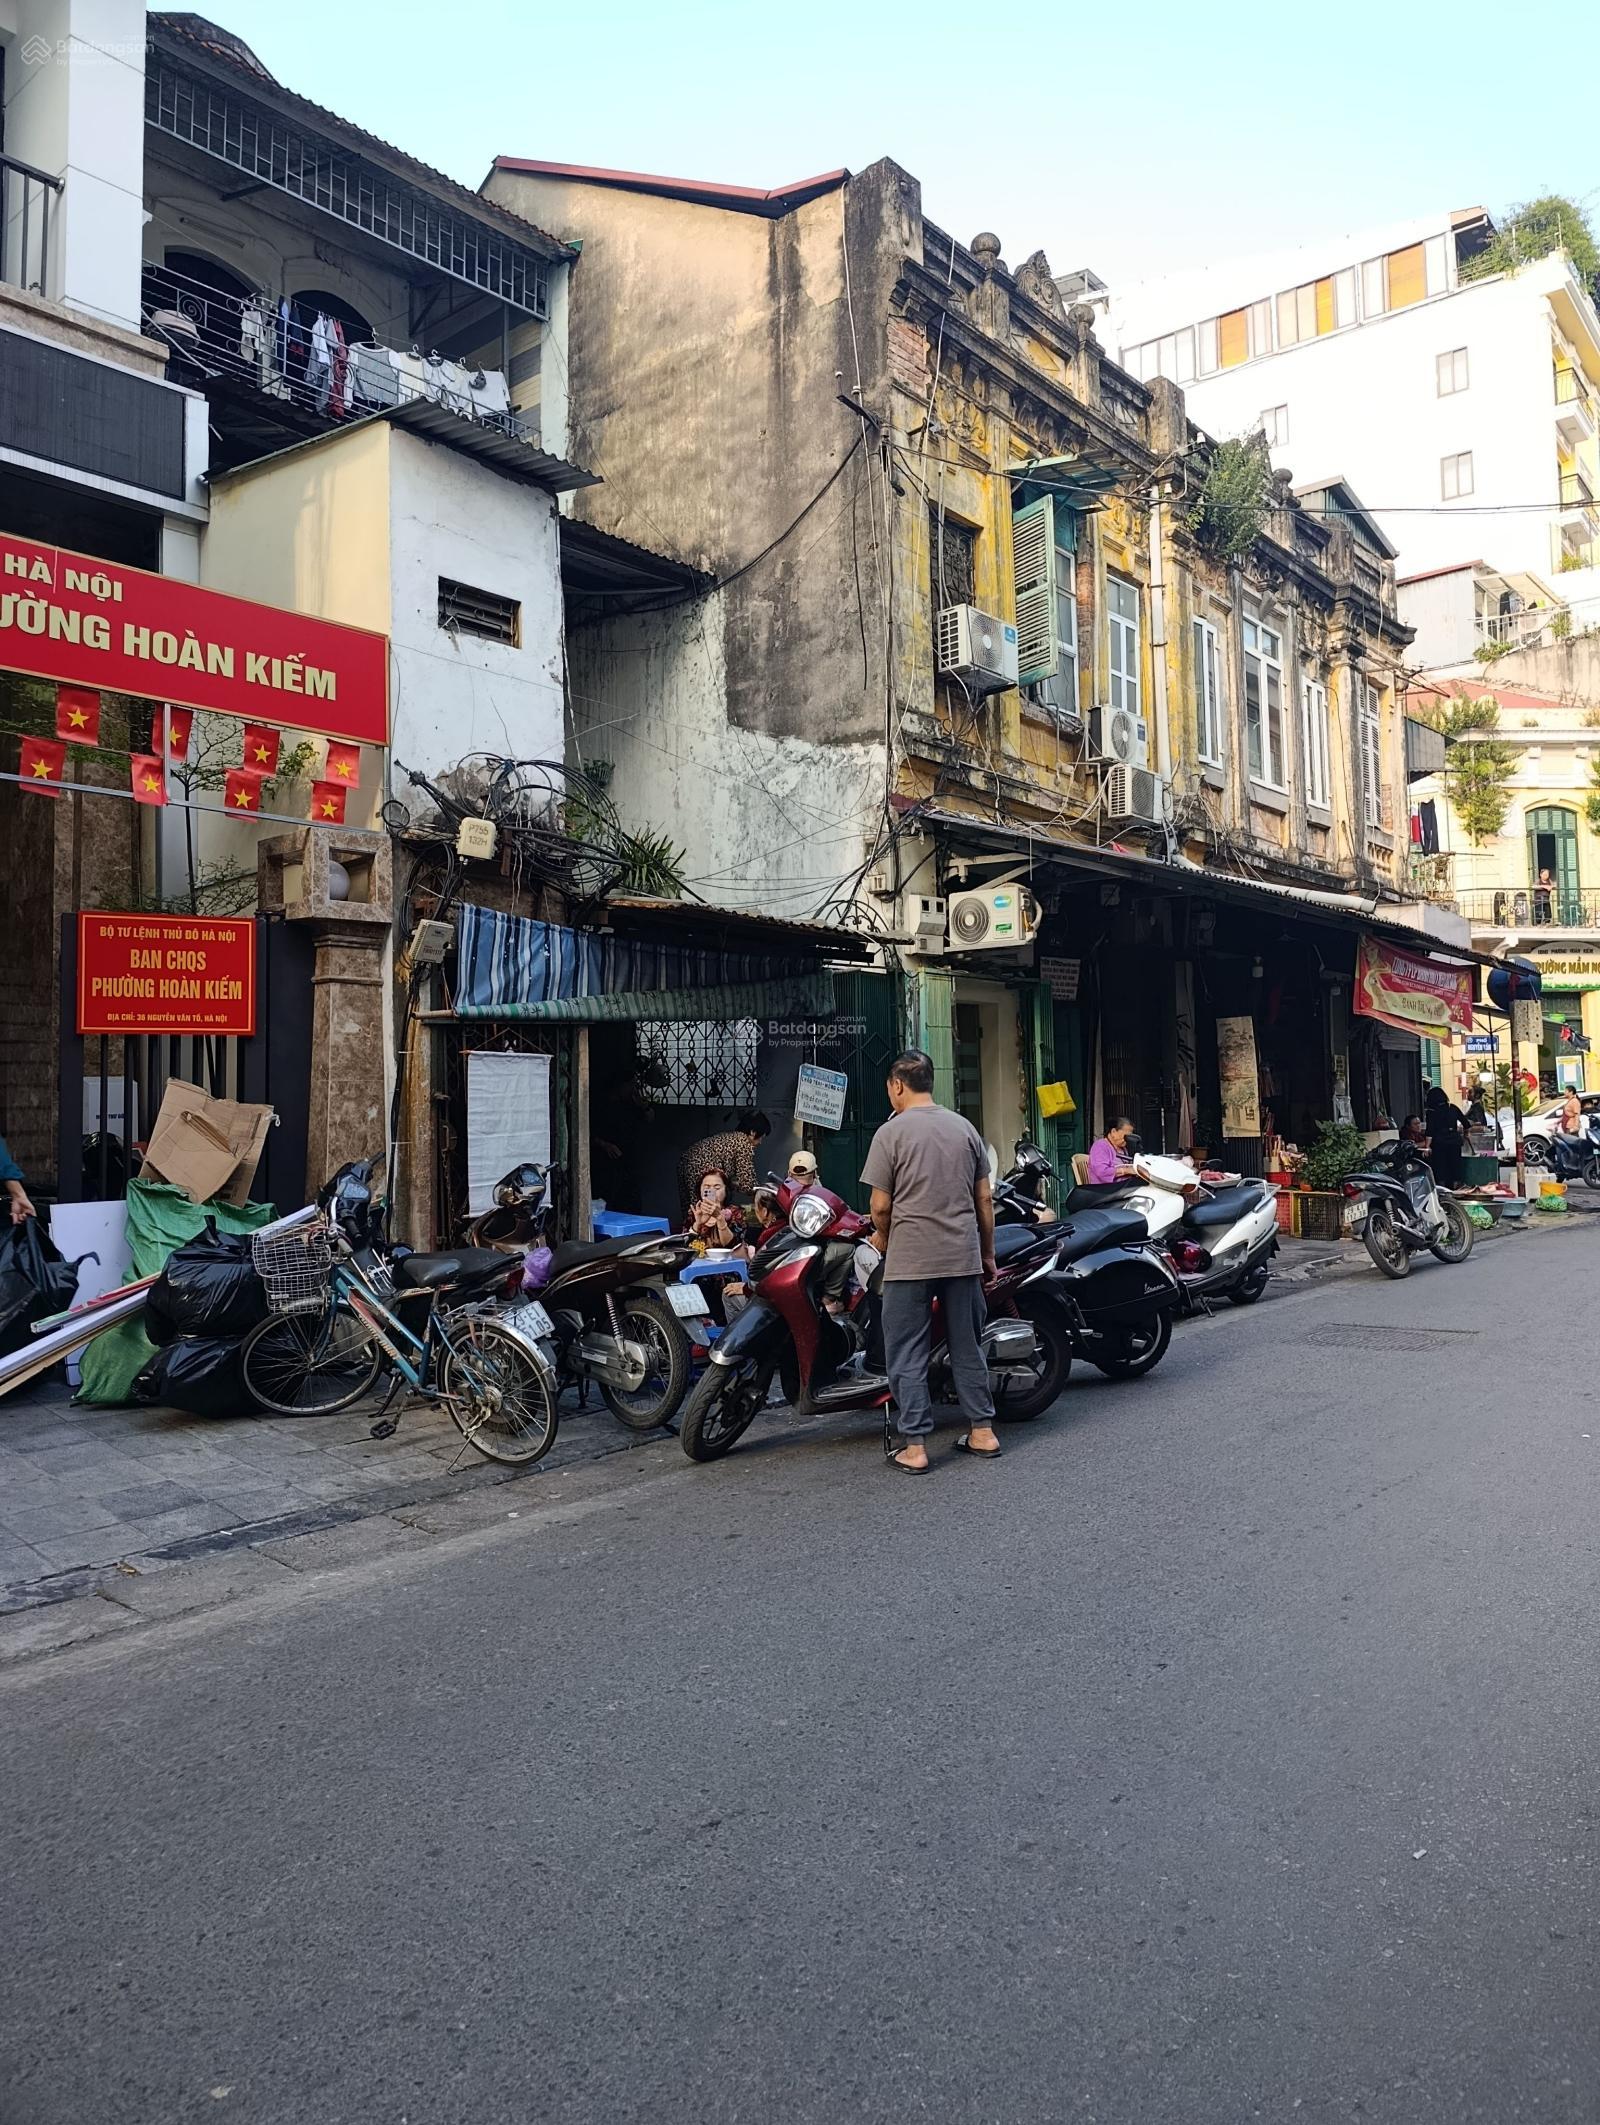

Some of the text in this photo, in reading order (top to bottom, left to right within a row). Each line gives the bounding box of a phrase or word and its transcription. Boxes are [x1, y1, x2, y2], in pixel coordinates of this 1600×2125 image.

[4, 552, 123, 603] HÀ NỘI
[123, 621, 235, 678] HOÀN
[245, 651, 337, 701] KIẾM
[100, 925, 236, 944] BỘ TƯ LỆNH THỦ ĐÔ HÀ NỘI
[130, 949, 207, 972] BAN CHQS
[92, 973, 242, 1000] PHƯỜNG HOÀN KIẾM
